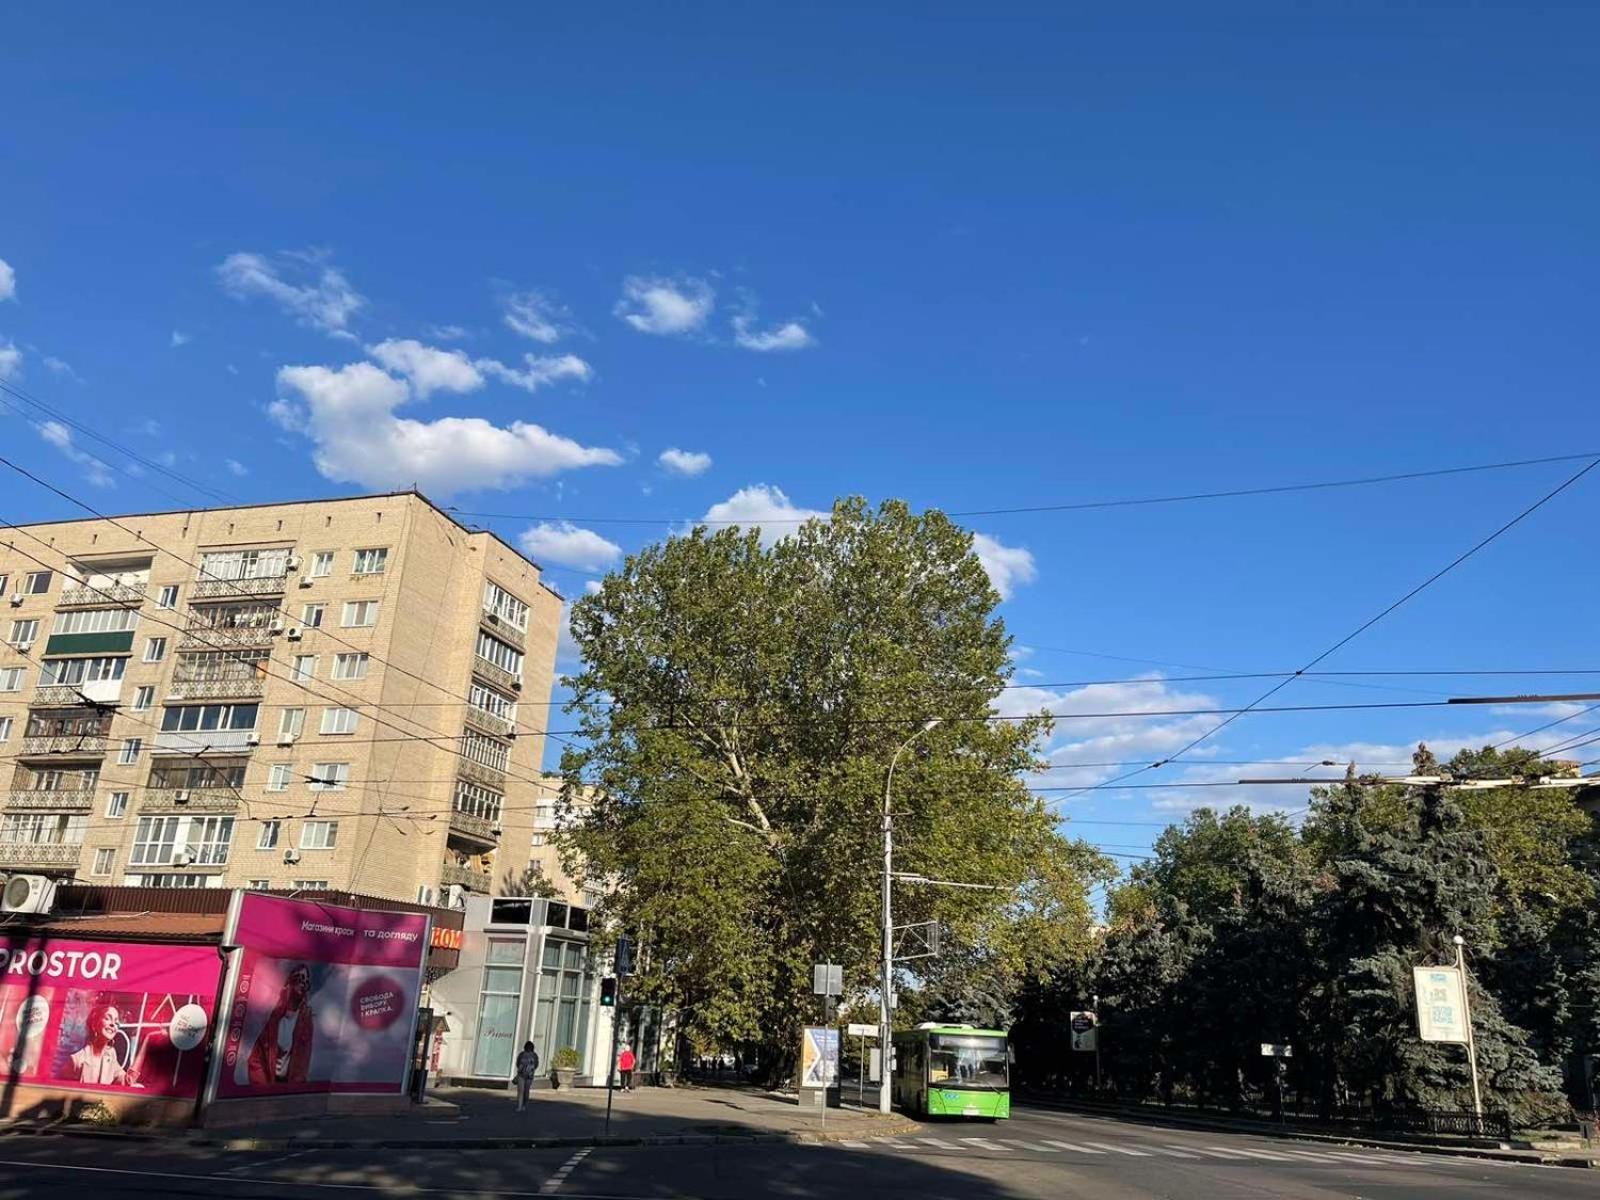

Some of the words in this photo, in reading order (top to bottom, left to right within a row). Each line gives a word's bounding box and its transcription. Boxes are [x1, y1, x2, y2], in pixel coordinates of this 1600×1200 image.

[363, 929, 376, 938] та
[377, 930, 419, 942] догляду
[360, 991, 394, 1004] СВОБОДА
